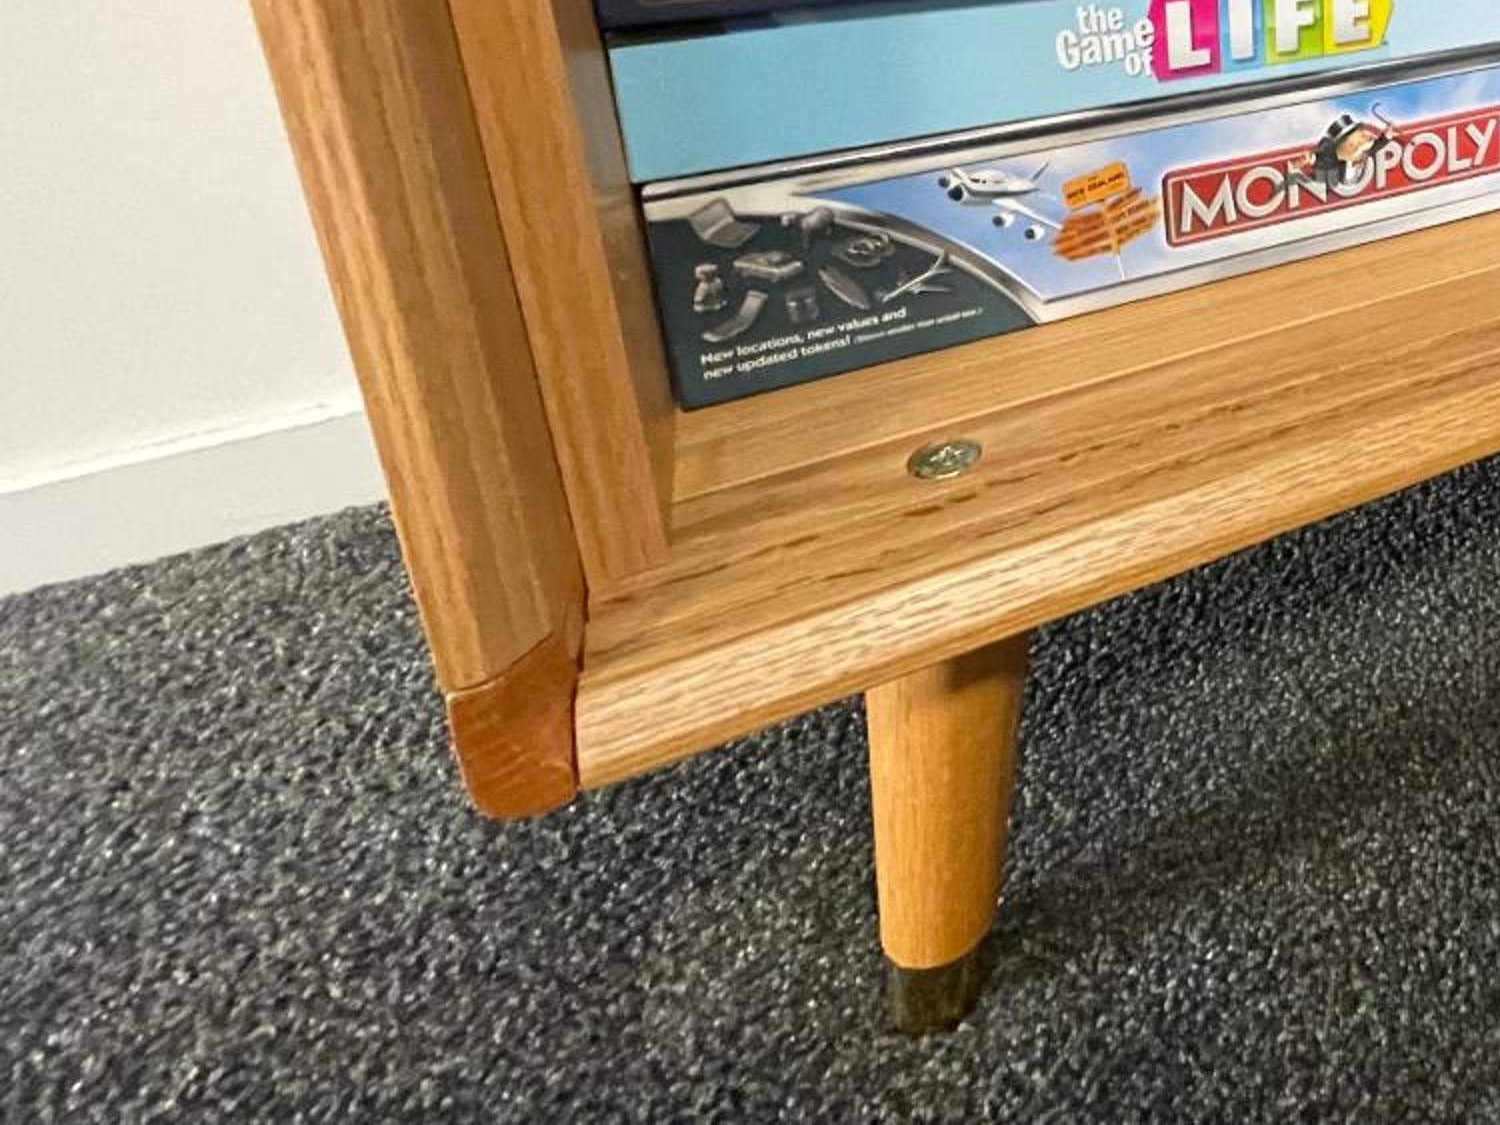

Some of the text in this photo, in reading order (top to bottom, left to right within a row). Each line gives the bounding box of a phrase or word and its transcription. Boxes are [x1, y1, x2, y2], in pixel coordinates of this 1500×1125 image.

[1056, 16, 1155, 71] Game
[1077, 3, 1124, 36] the
[1125, 51, 1154, 76] of
[1180, 118, 1498, 234] MONOPOLY
[701, 350, 733, 366] New
[737, 332, 804, 357] locations,
[807, 324, 835, 339] new
[837, 315, 880, 333] values
[881, 307, 908, 322] and
[703, 335, 851, 380] new updated tokens!
